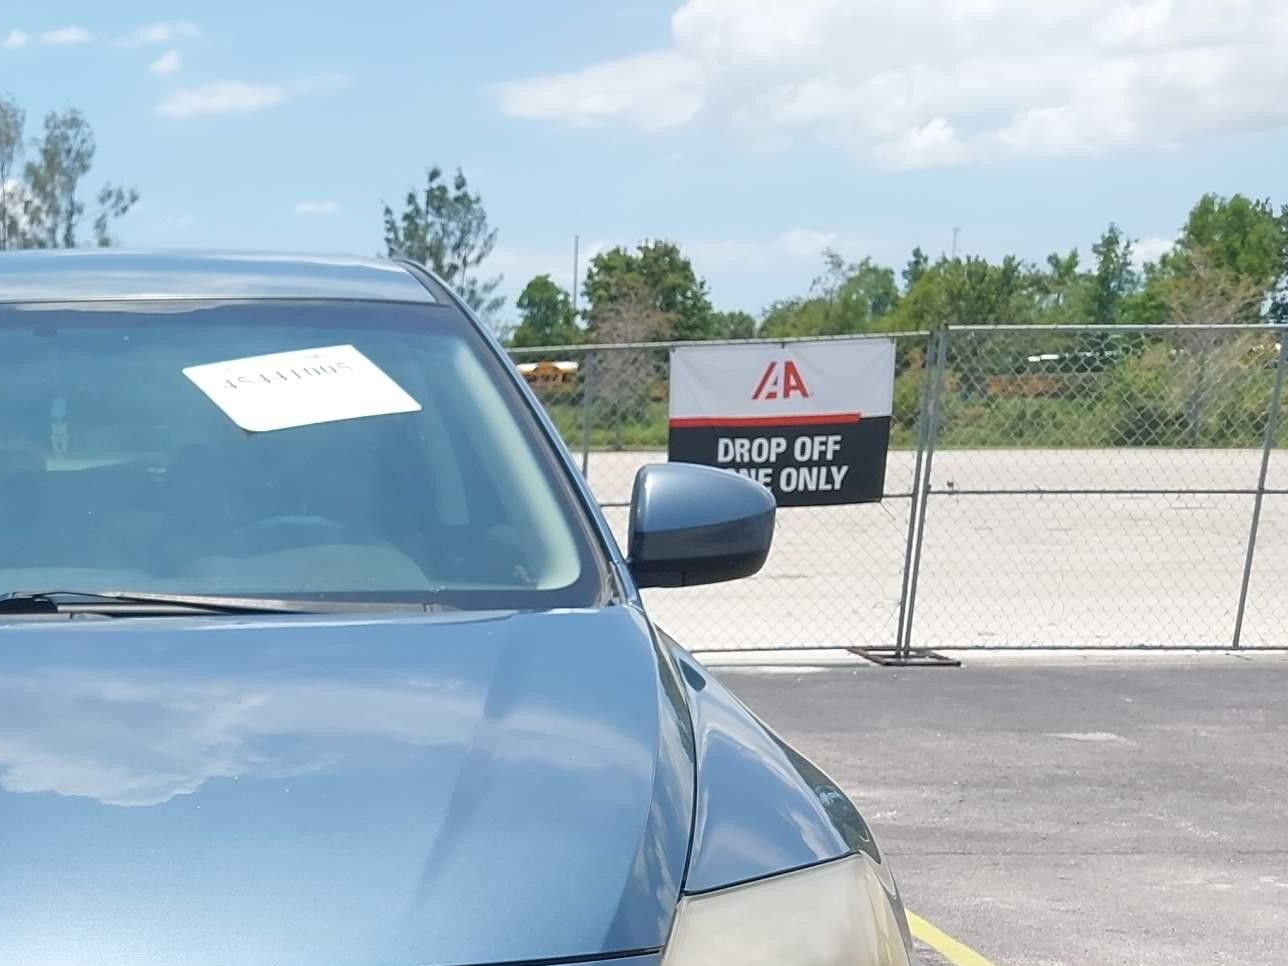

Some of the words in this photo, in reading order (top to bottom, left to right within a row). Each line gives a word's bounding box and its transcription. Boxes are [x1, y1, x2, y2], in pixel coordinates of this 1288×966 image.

[717, 437, 788, 464] DROP
[793, 434, 842, 462] OFF
[779, 464, 849, 493] ONLY
